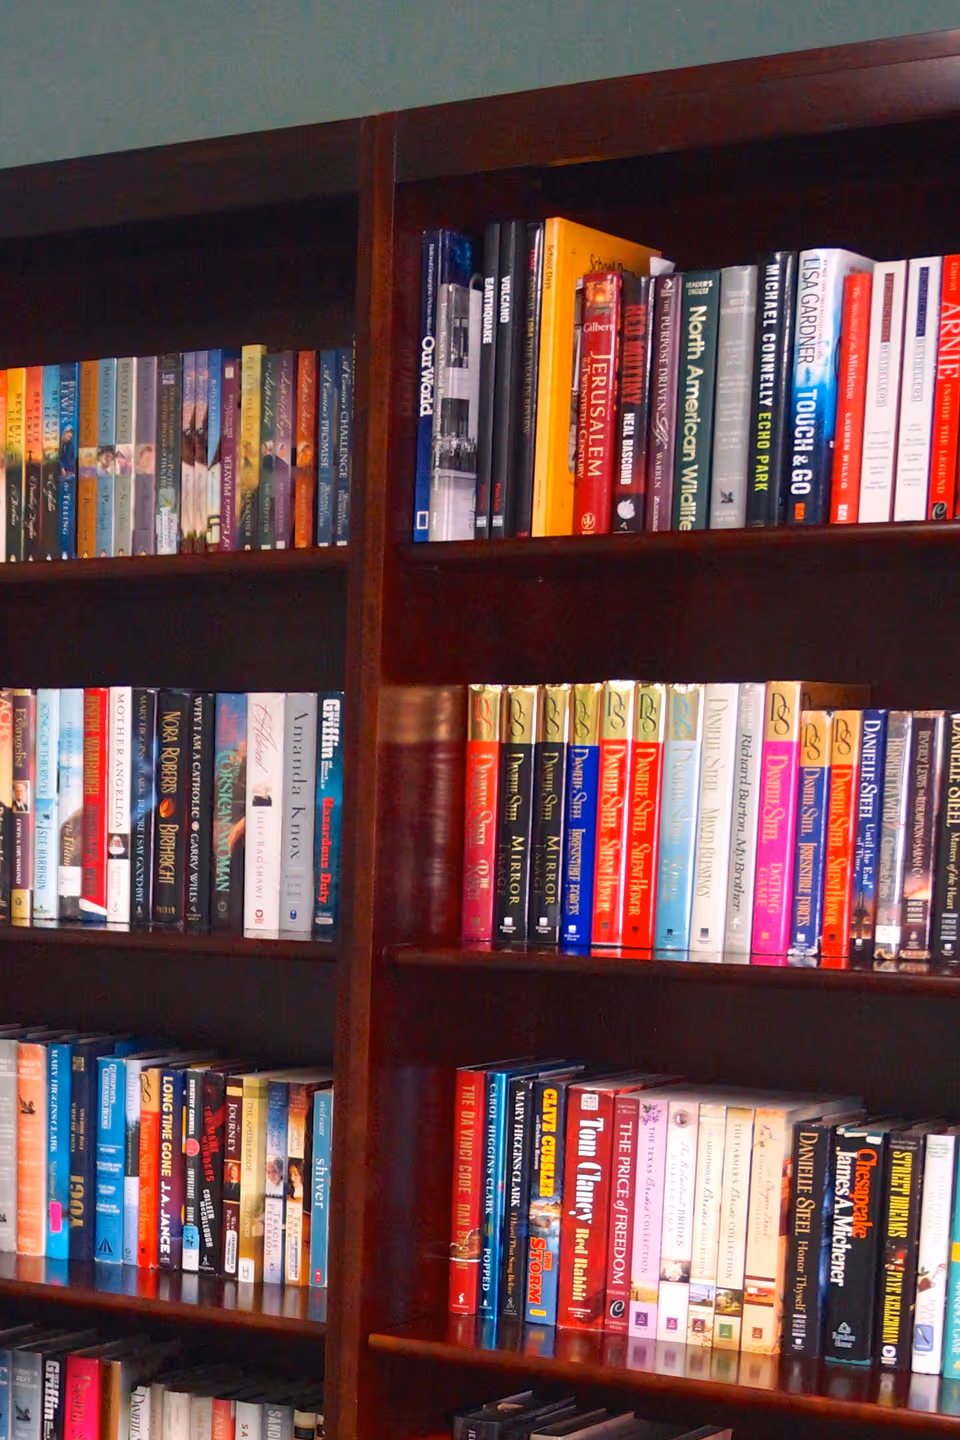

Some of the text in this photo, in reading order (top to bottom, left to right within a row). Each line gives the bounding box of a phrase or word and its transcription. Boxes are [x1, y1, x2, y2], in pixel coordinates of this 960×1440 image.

[483, 277, 495, 343] EARTHQUAKE
[499, 276, 511, 323] VOLCANO
[798, 258, 821, 364] LISA GARDNER
[419, 336, 435, 416] Our World
[587, 351, 612, 476] JERUSALEM
[654, 300, 671, 488] THE PURPOSE DRIVEN WARREN
[679, 306, 707, 531] North American Wildlife
[755, 264, 779, 492] MICHAEL CONNELLY ECHO PARK
[846, 354, 858, 399] Mistletoe
[937, 302, 960, 494] ARNIE INSIDE THE LEGEND
[320, 420, 329, 468] PROMISE
[339, 412, 348, 478] CHALLENGE
[621, 412, 635, 484] NEAL BASCOMB
[792, 389, 818, 494] TOUCH & GO
[841, 412, 852, 488] LAUREN WILLIG
[115, 693, 125, 828] MOTHER ANGELICA
[193, 733, 201, 749] AM
[194, 697, 202, 724] WHY
[158, 711, 180, 884] NORA ROBERTS BIRTHRIGHT
[191, 762, 200, 818] CATHOLIC
[290, 710, 310, 860] Amanda Knox
[318, 699, 341, 903] Griffin Hazardous Duty
[858, 720, 881, 885] DANIELLE STEEL Until the End
[189, 834, 199, 868] GARRY
[189, 873, 197, 902] WILLS
[509, 836, 524, 905] MIRROR
[160, 1076, 174, 1253] LONG TIME GONE J.A. JANCE
[314, 1158, 328, 1209] shiver
[456, 1085, 474, 1270] THE DA VINCI CODE DAN BROWN
[482, 1084, 497, 1291] CAROL HIGGINS CLARK POPPED
[510, 1091, 525, 1207] MARY HIGGINS CLARK
[540, 1088, 557, 1197] CLIVE CUSSLER
[849, 1149, 878, 1238] Chesapeake
[888, 1151, 912, 1237] STREET DREAMS
[569, 1118, 605, 1301] Tom Clancy Red Rabbit
[613, 1122, 633, 1284] THE PRICE of FREEDOM
[794, 1132, 819, 1313] DANIELLE STEEL Honor Thyself
[830, 1146, 857, 1286] James A. Michener
[528, 1237, 546, 1304] STORM
[543, 1251, 552, 1271] THE
[883, 1271, 902, 1344] FAYE KELLERMAN
